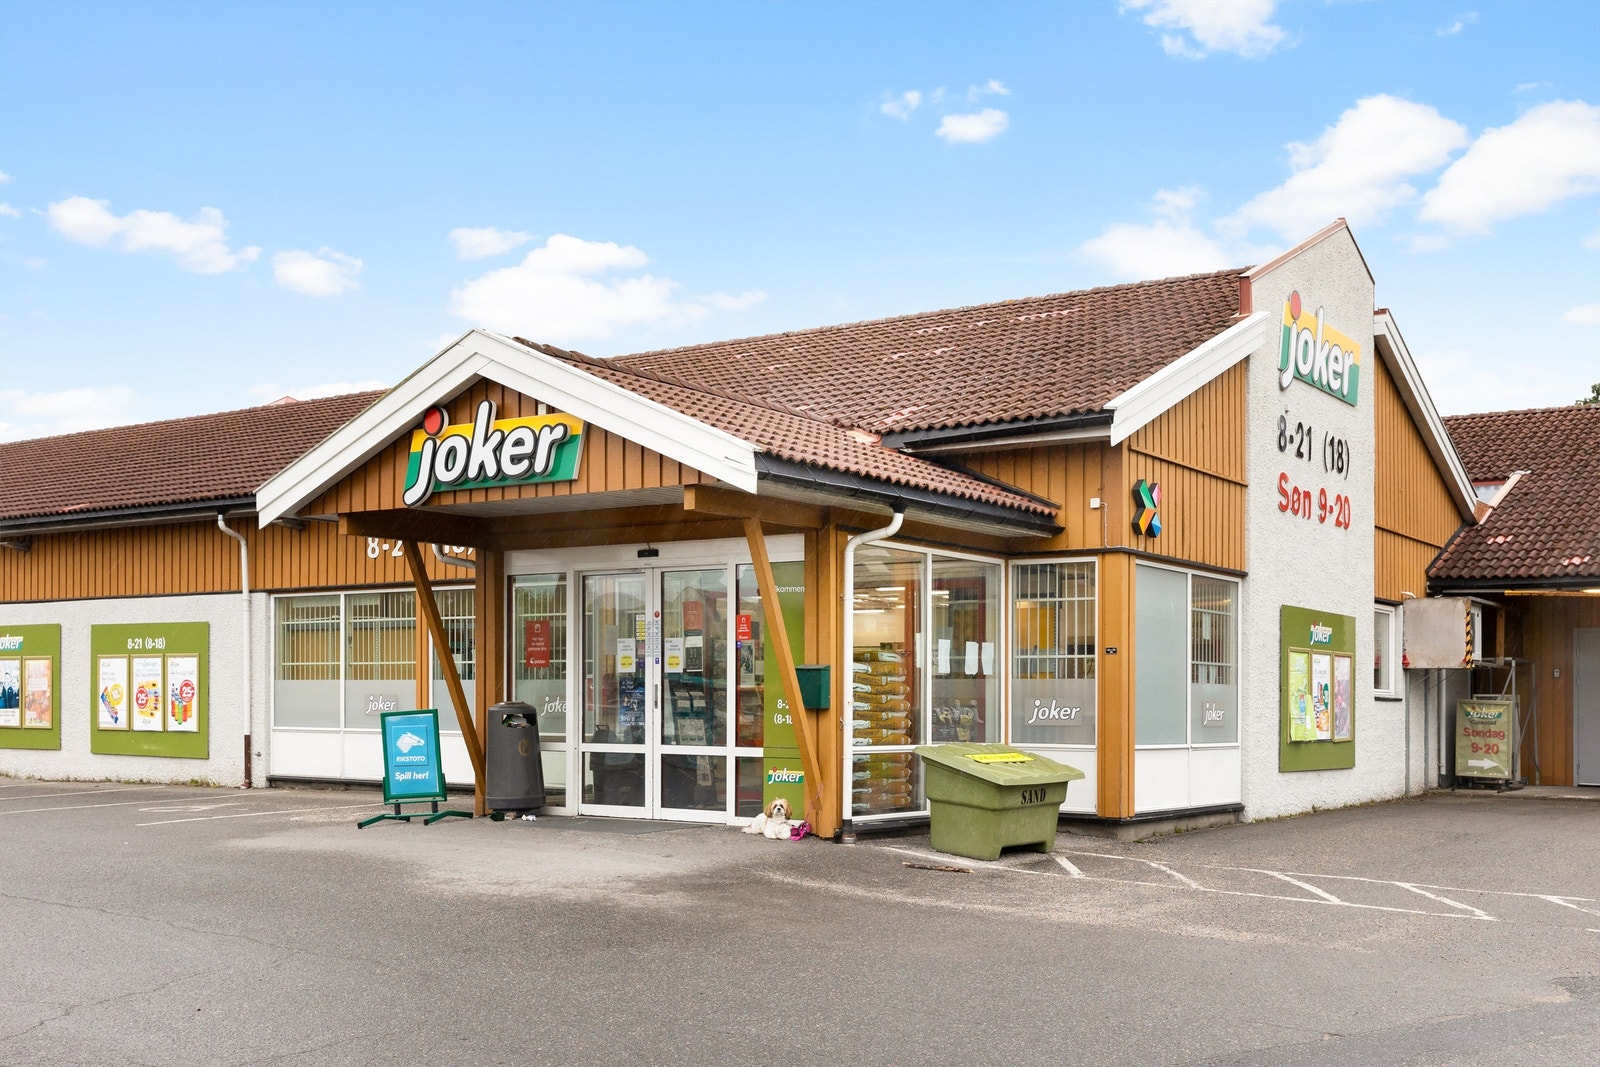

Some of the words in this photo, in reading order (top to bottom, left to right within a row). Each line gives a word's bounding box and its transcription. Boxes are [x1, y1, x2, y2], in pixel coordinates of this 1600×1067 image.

[1280, 290, 1354, 398] joker
[403, 400, 571, 507] joker
[1323, 430, 1350, 480] (18)
[1277, 472, 1312, 520] Søn
[0, 633, 23, 649] oker
[1310, 620, 1332, 646] joker
[145, 636, 166, 650] (8-18)
[366, 696, 396, 714] joker
[541, 696, 567, 716] joke
[1028, 699, 1080, 725] joker
[1204, 702, 1225, 725] joker
[1463, 727, 1505, 740] Søndag
[396, 755, 426, 763] RIKSTOTO
[395, 771, 412, 781] Spill
[413, 770, 430, 780] her!
[768, 767, 801, 784] joker
[1021, 788, 1047, 805] SAND
